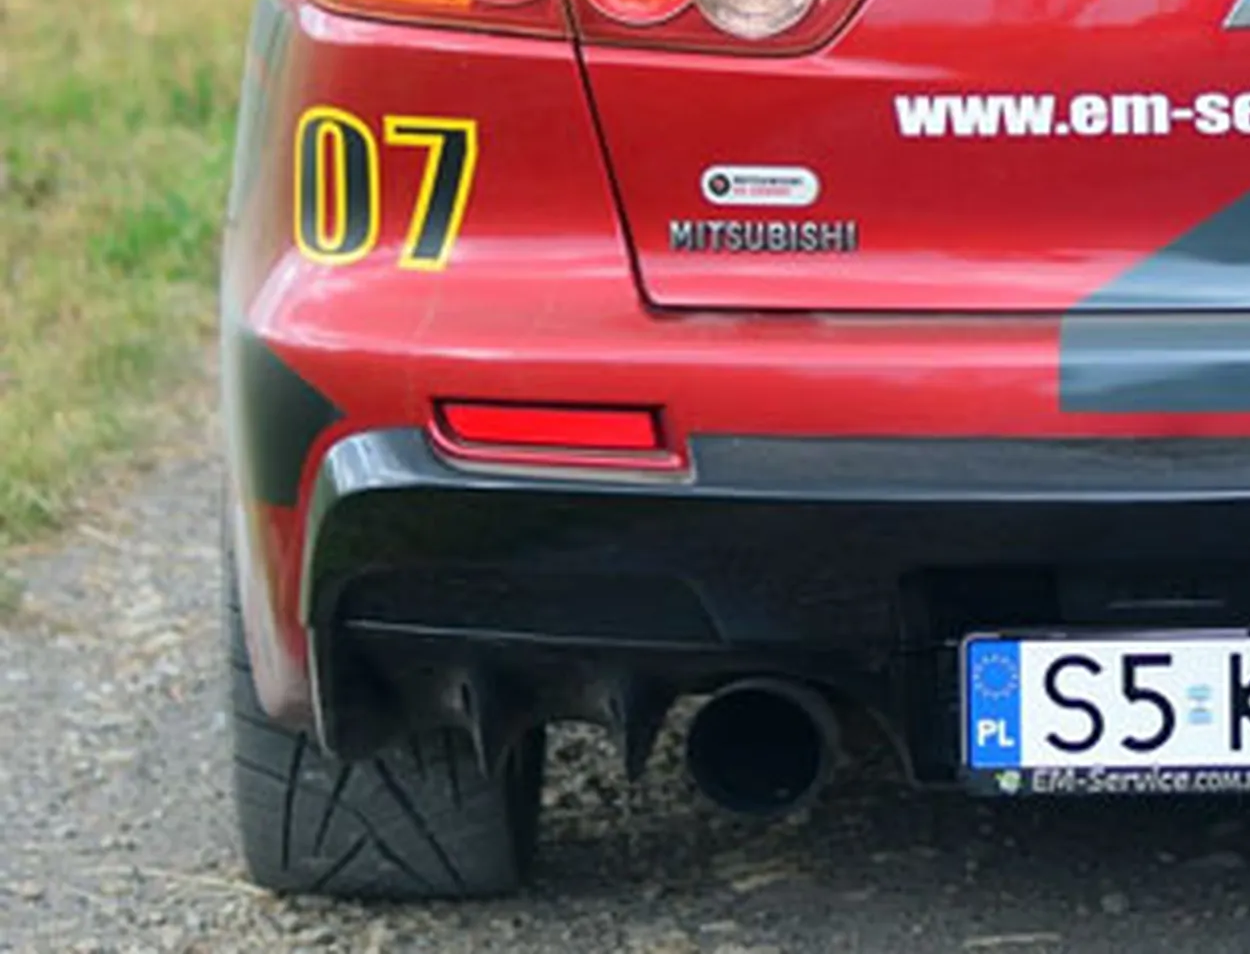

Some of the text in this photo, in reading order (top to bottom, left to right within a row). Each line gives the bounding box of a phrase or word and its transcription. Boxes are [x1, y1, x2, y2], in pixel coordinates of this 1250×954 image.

[294, 104, 479, 272] 07
[669, 219, 859, 253] MITSUBISHI
[976, 719, 1014, 747] PL
[1043, 653, 1177, 753] S5
